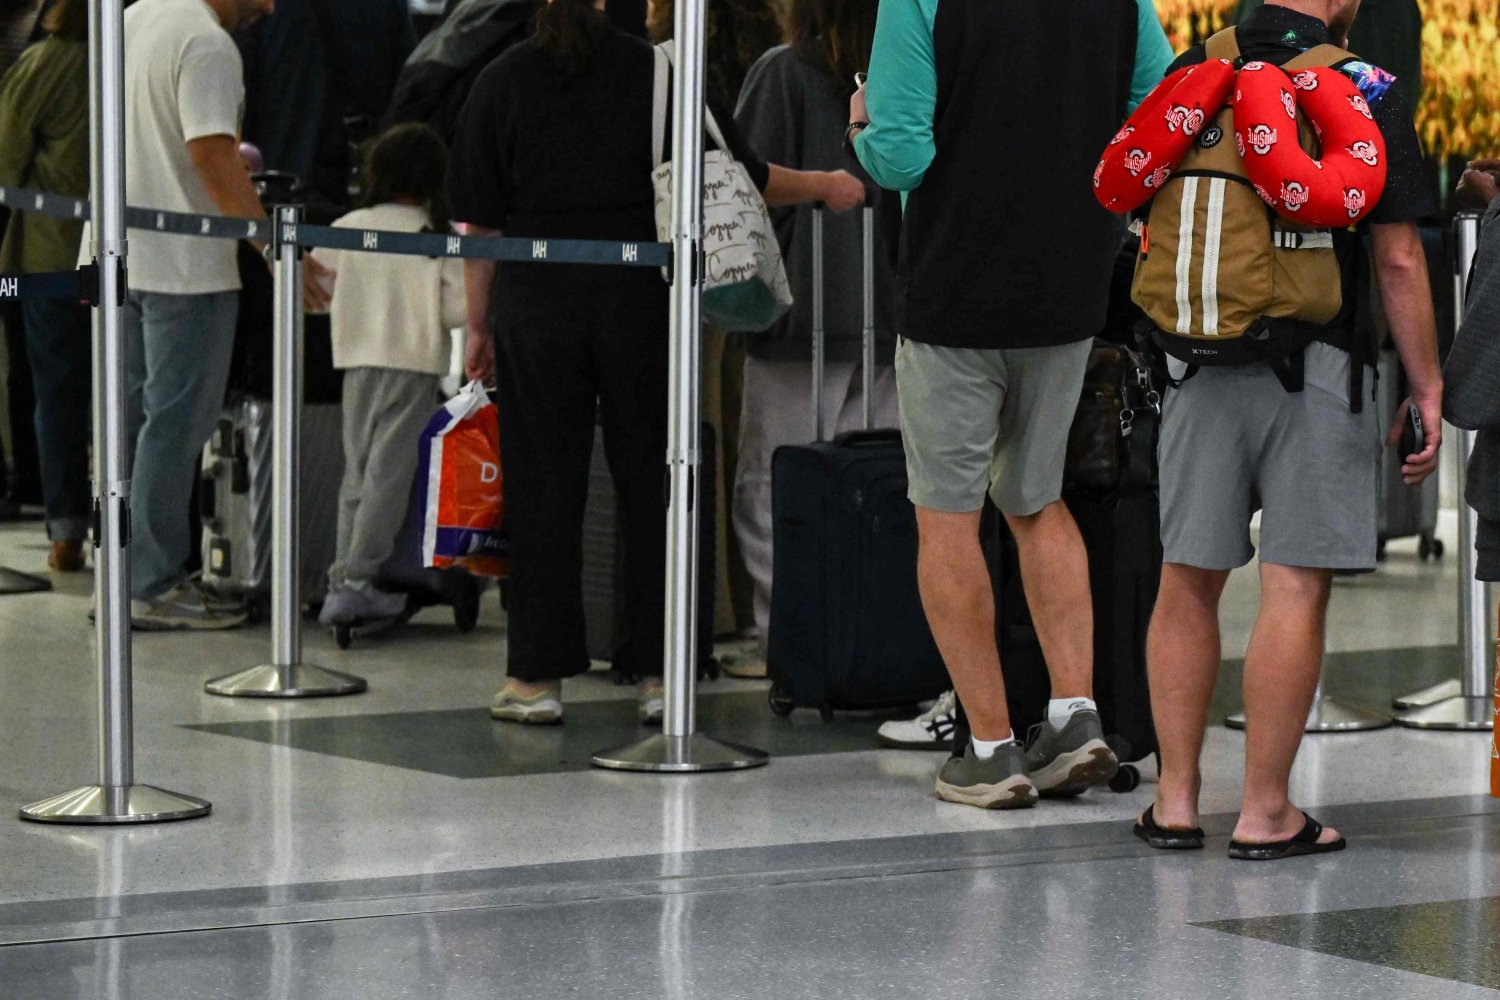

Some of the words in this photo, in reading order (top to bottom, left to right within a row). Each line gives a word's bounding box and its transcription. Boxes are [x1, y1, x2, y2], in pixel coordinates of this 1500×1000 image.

[282, 223, 297, 242] IAH
[363, 231, 378, 249] IAH
[446, 236, 461, 254] IAH
[532, 240, 548, 259] IAH
[621, 243, 638, 262] IAH
